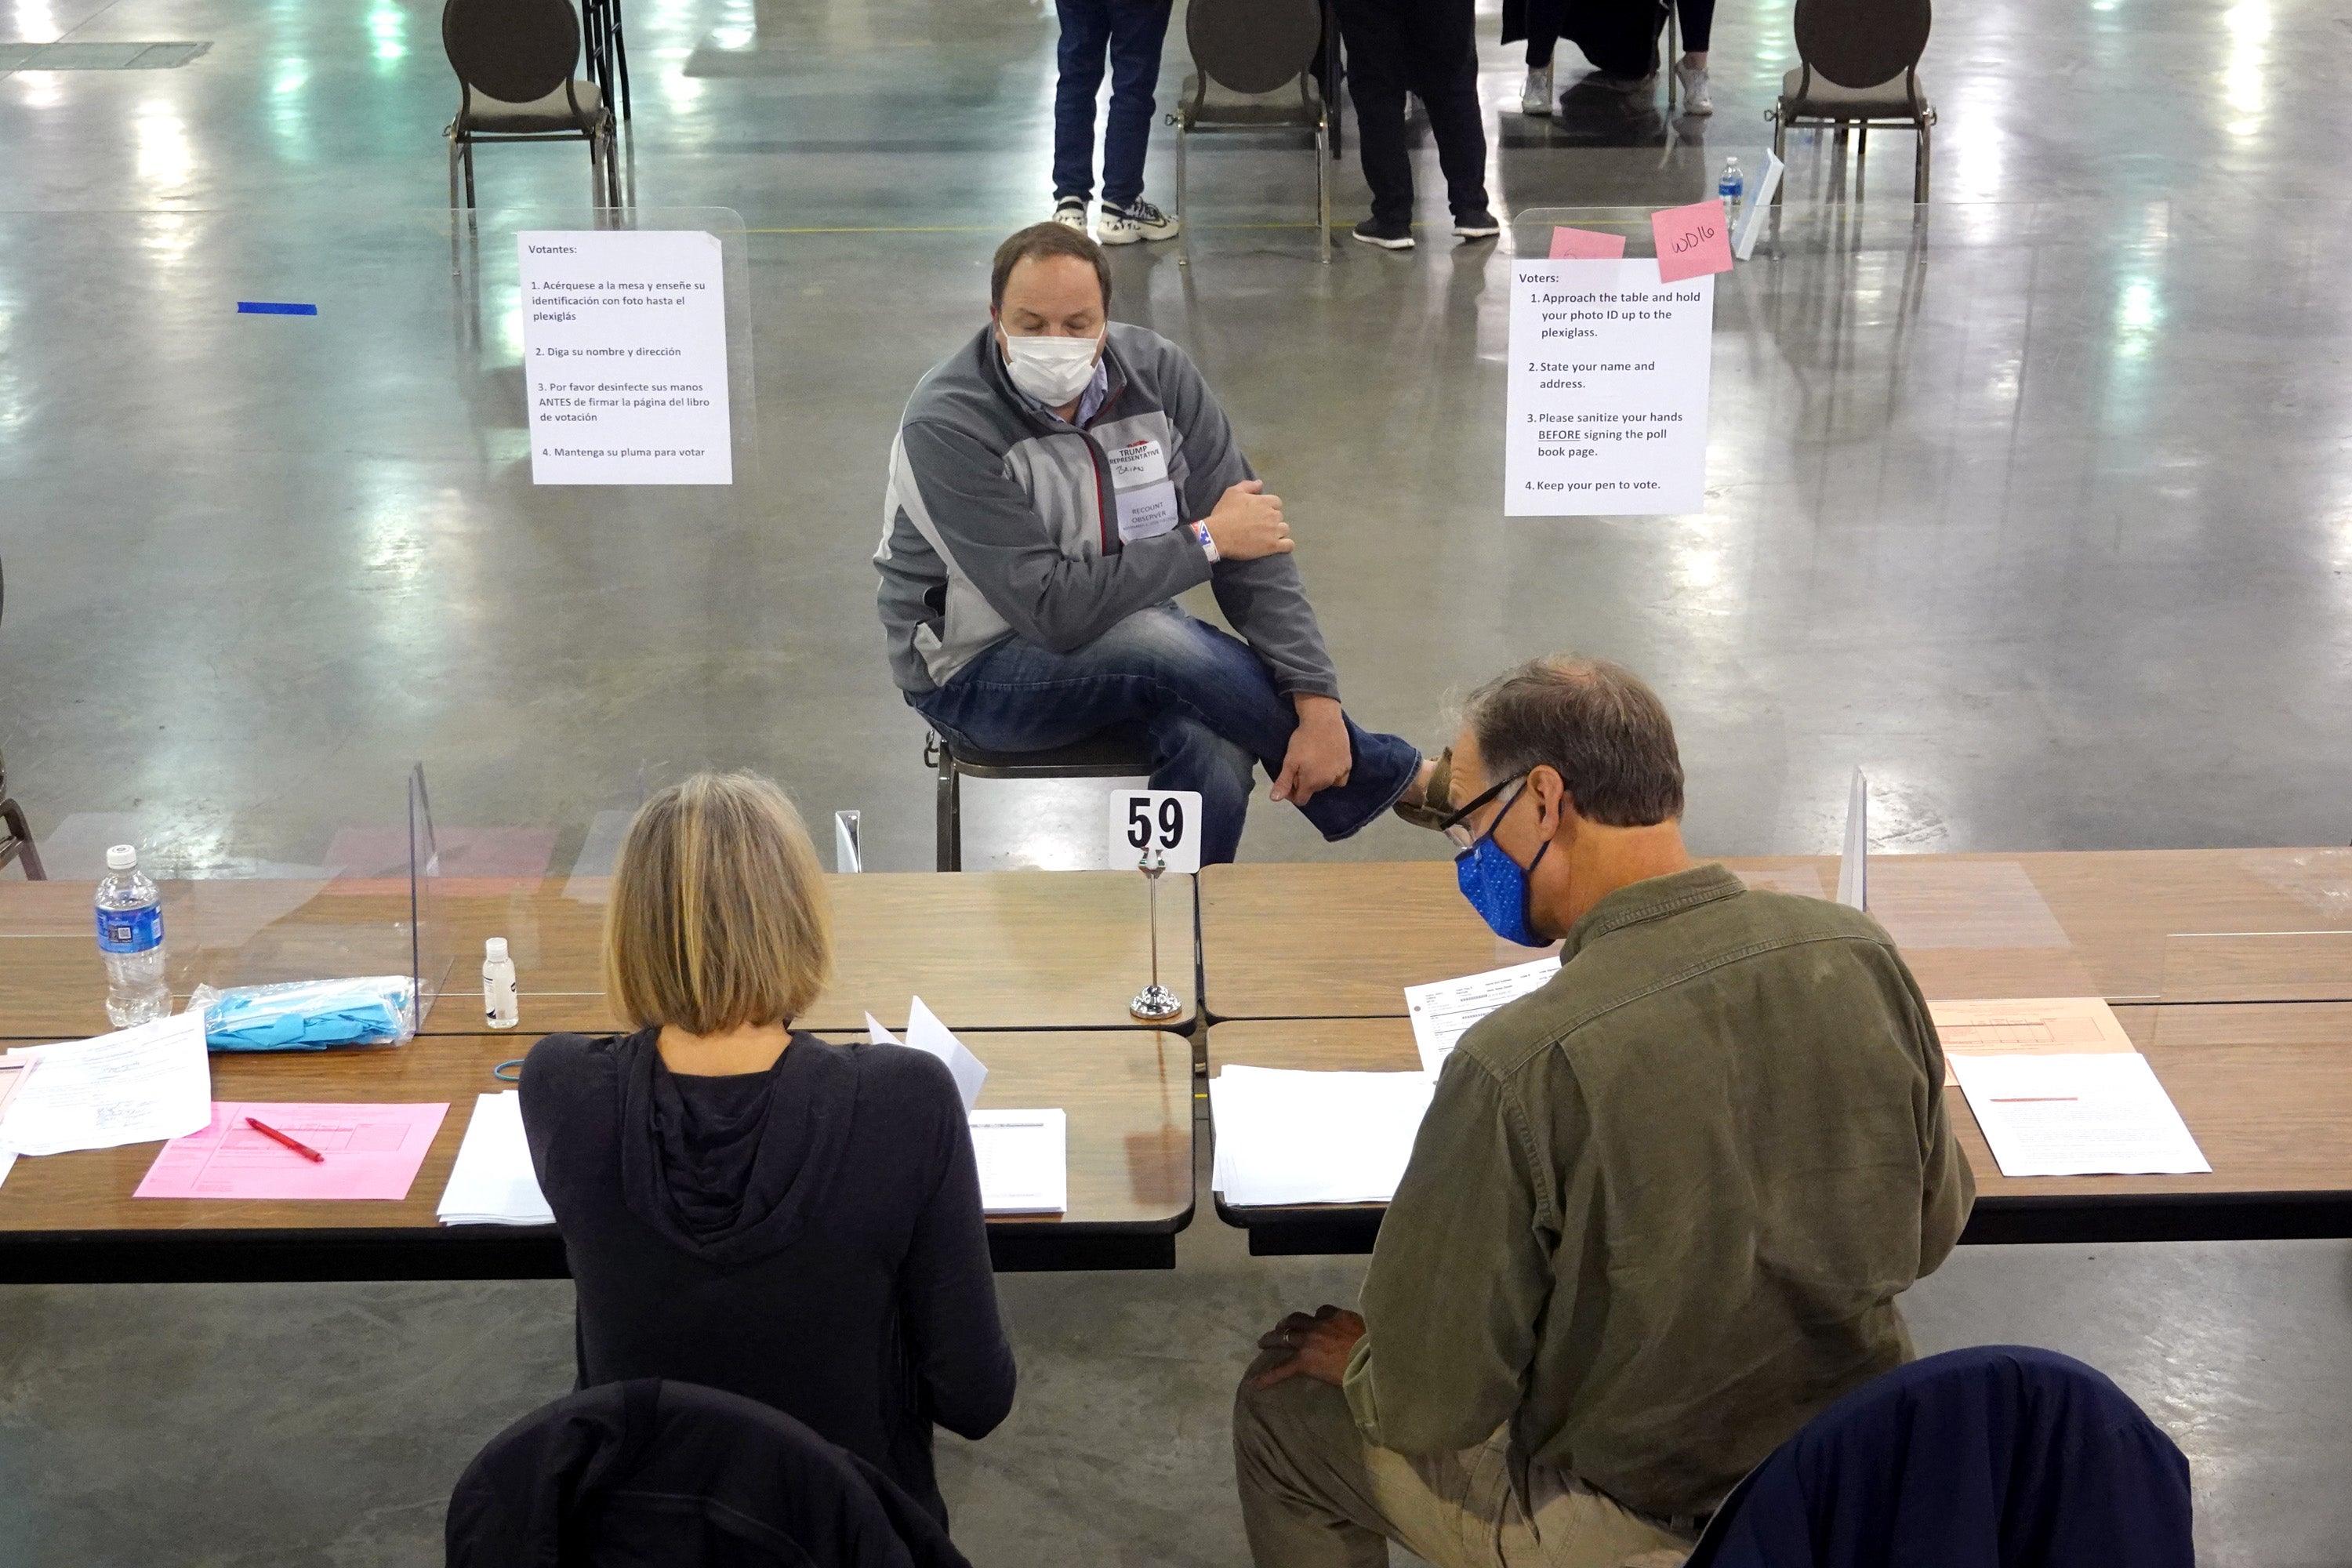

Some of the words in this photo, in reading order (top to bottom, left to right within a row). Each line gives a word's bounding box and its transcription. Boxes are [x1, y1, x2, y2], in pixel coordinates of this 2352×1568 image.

[528, 245, 578, 254] Votantes:
[1519, 273, 1561, 284] Voters:
[531, 281, 541, 290] 1.
[543, 281, 596, 292] Acérquese
[606, 281, 615, 290] la
[647, 283, 654, 292] y
[655, 281, 692, 290] enseñe
[532, 296, 600, 306] identificación
[622, 296, 644, 306] foto
[645, 296, 673, 306] hasta
[676, 296, 685, 306] el
[1530, 293, 1541, 303] 1.
[1541, 292, 1596, 306] Approach
[1599, 292, 1618, 303] the
[1620, 292, 1650, 303] table
[1651, 291, 1673, 303] and
[1675, 291, 1700, 302] hold
[532, 311, 577, 323] plexiglás
[1541, 312, 1568, 323] your
[1570, 310, 1604, 322] photo
[1606, 310, 1619, 320] ID
[1621, 311, 1636, 322] up
[1638, 310, 1651, 320] to
[1653, 309, 1672, 320] the
[1541, 326, 1598, 340] plexiglass.
[535, 347, 545, 357] 2.
[547, 347, 570, 358] Diga
[586, 347, 626, 357] nombre
[626, 349, 633, 358] y
[635, 347, 681, 357] dirección
[1528, 361, 1538, 372] 2.
[1540, 361, 1570, 372] State
[1571, 363, 1598, 374] your
[1600, 363, 1632, 372] name
[1634, 361, 1656, 372] and
[537, 383, 547, 392] 3.
[550, 383, 568, 392] Por
[568, 382, 596, 392] favor
[597, 382, 649, 392] desinfecte
[1539, 378, 1586, 389] address.
[539, 397, 572, 407] ANTES
[573, 397, 586, 407] de
[588, 397, 620, 407] firmar
[621, 397, 631, 407] la
[633, 397, 666, 408] página
[668, 397, 684, 407] del
[687, 397, 710, 407] libro
[539, 412, 553, 422] de
[554, 412, 597, 422] votación
[1526, 413, 1537, 423] 3.
[1538, 412, 1574, 423] Please
[1577, 412, 1619, 423] sanitize
[1621, 414, 1648, 425] your
[1650, 412, 1683, 422] hands
[1537, 430, 1581, 442] BEFORE
[1584, 429, 1623, 441] signing
[1624, 429, 1643, 439] the
[1646, 428, 1668, 441] poll
[542, 448, 552, 457] 4.
[554, 448, 604, 459] Mantenga
[620, 447, 652, 459] pluma
[654, 449, 677, 459] para
[678, 448, 706, 457] votar
[1109, 449, 1160, 464] REPRESENTATIVE
[1120, 445, 1148, 456] TRUMP
[1537, 446, 1566, 457] book
[1568, 448, 1599, 459] page.
[1524, 481, 1535, 491] 4.
[1537, 481, 1565, 492] Keep
[1566, 482, 1593, 492] your
[1595, 482, 1616, 492] pen
[1618, 481, 1631, 490] to
[1632, 480, 1661, 490] vote.
[1132, 502, 1163, 514] RECOUNT
[1131, 511, 1167, 523] OBSERVER
[1127, 797, 1184, 849] 59
